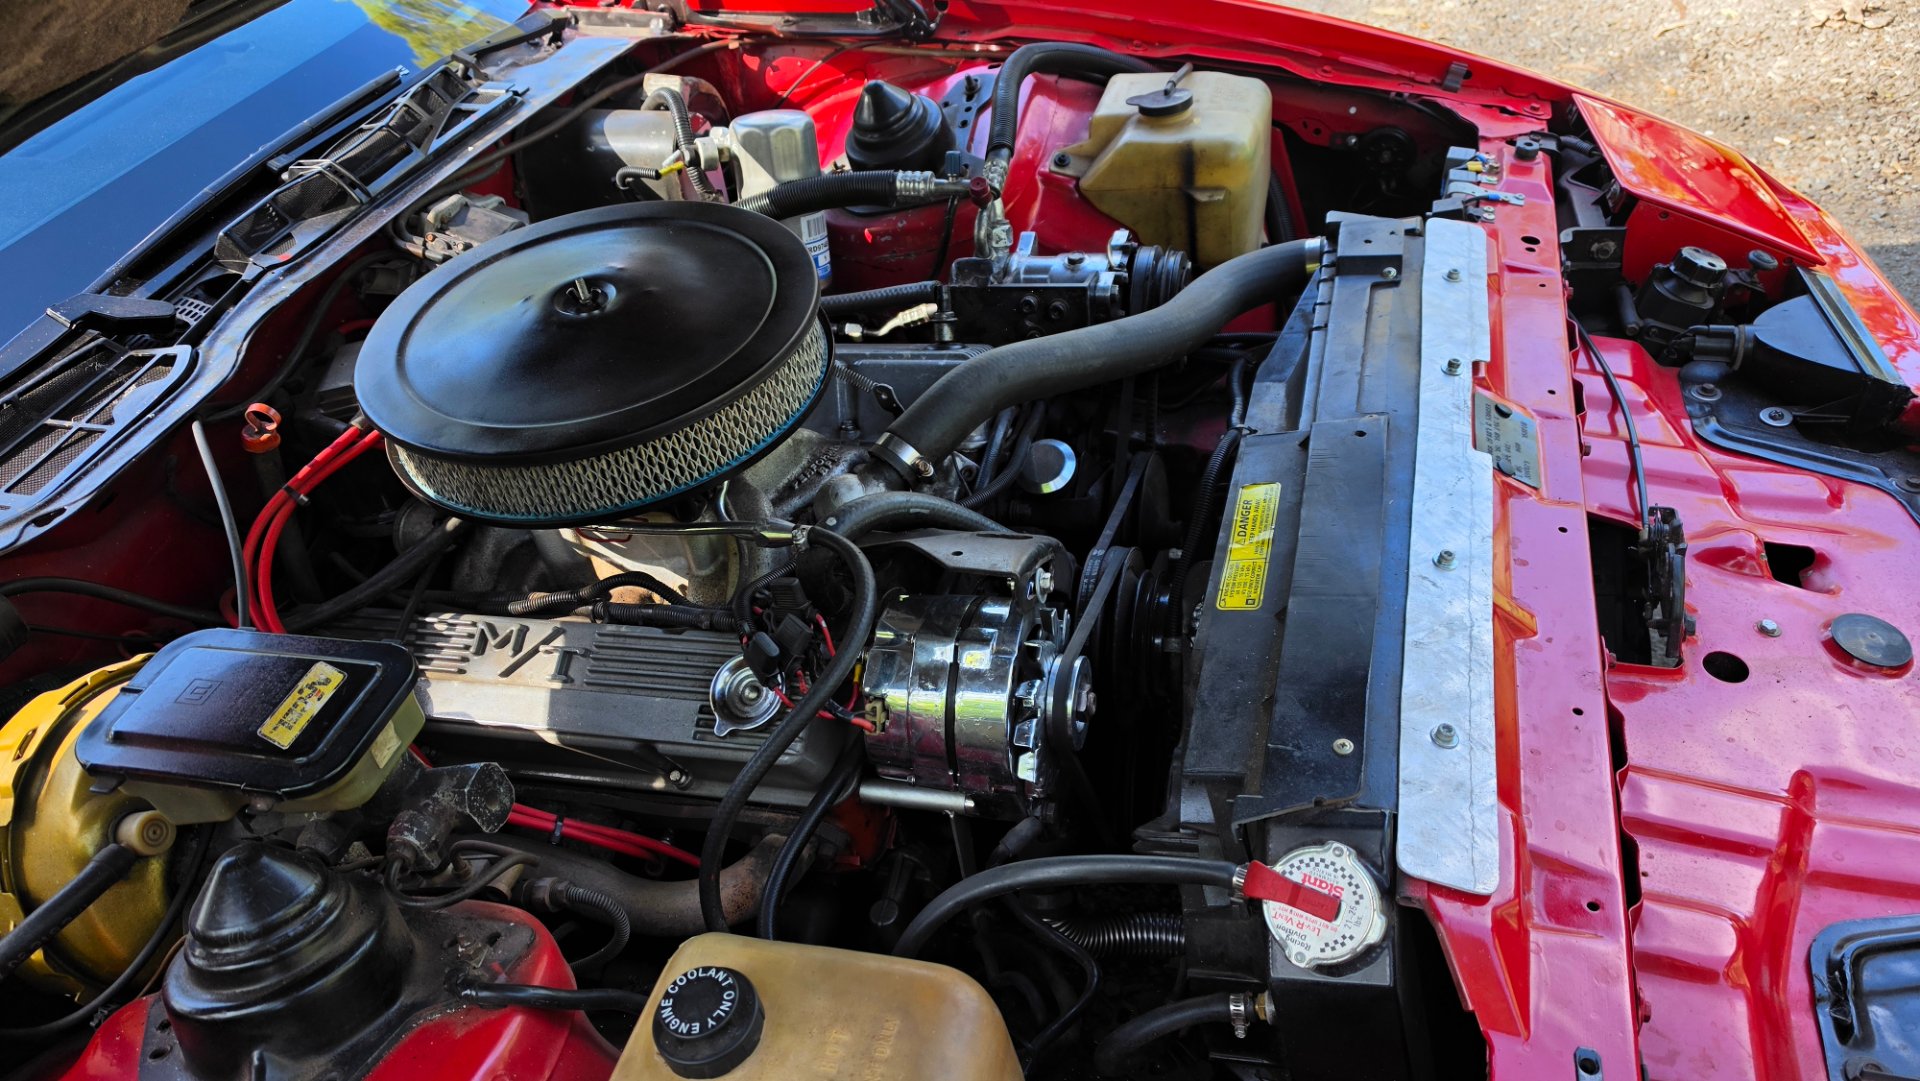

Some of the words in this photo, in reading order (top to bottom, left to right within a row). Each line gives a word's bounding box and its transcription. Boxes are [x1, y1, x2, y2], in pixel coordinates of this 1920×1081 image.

[1237, 499, 1252, 537] DANGER
[471, 621, 592, 683] M/T
[1301, 873, 1345, 899] Stant
[1344, 905, 1358, 930] 21-25
[1277, 924, 1307, 941] Division
[1285, 935, 1312, 952] Racing
[668, 967, 734, 994] COOLANT
[661, 998, 700, 1034] ENGINE
[706, 990, 735, 1028] ONLY
